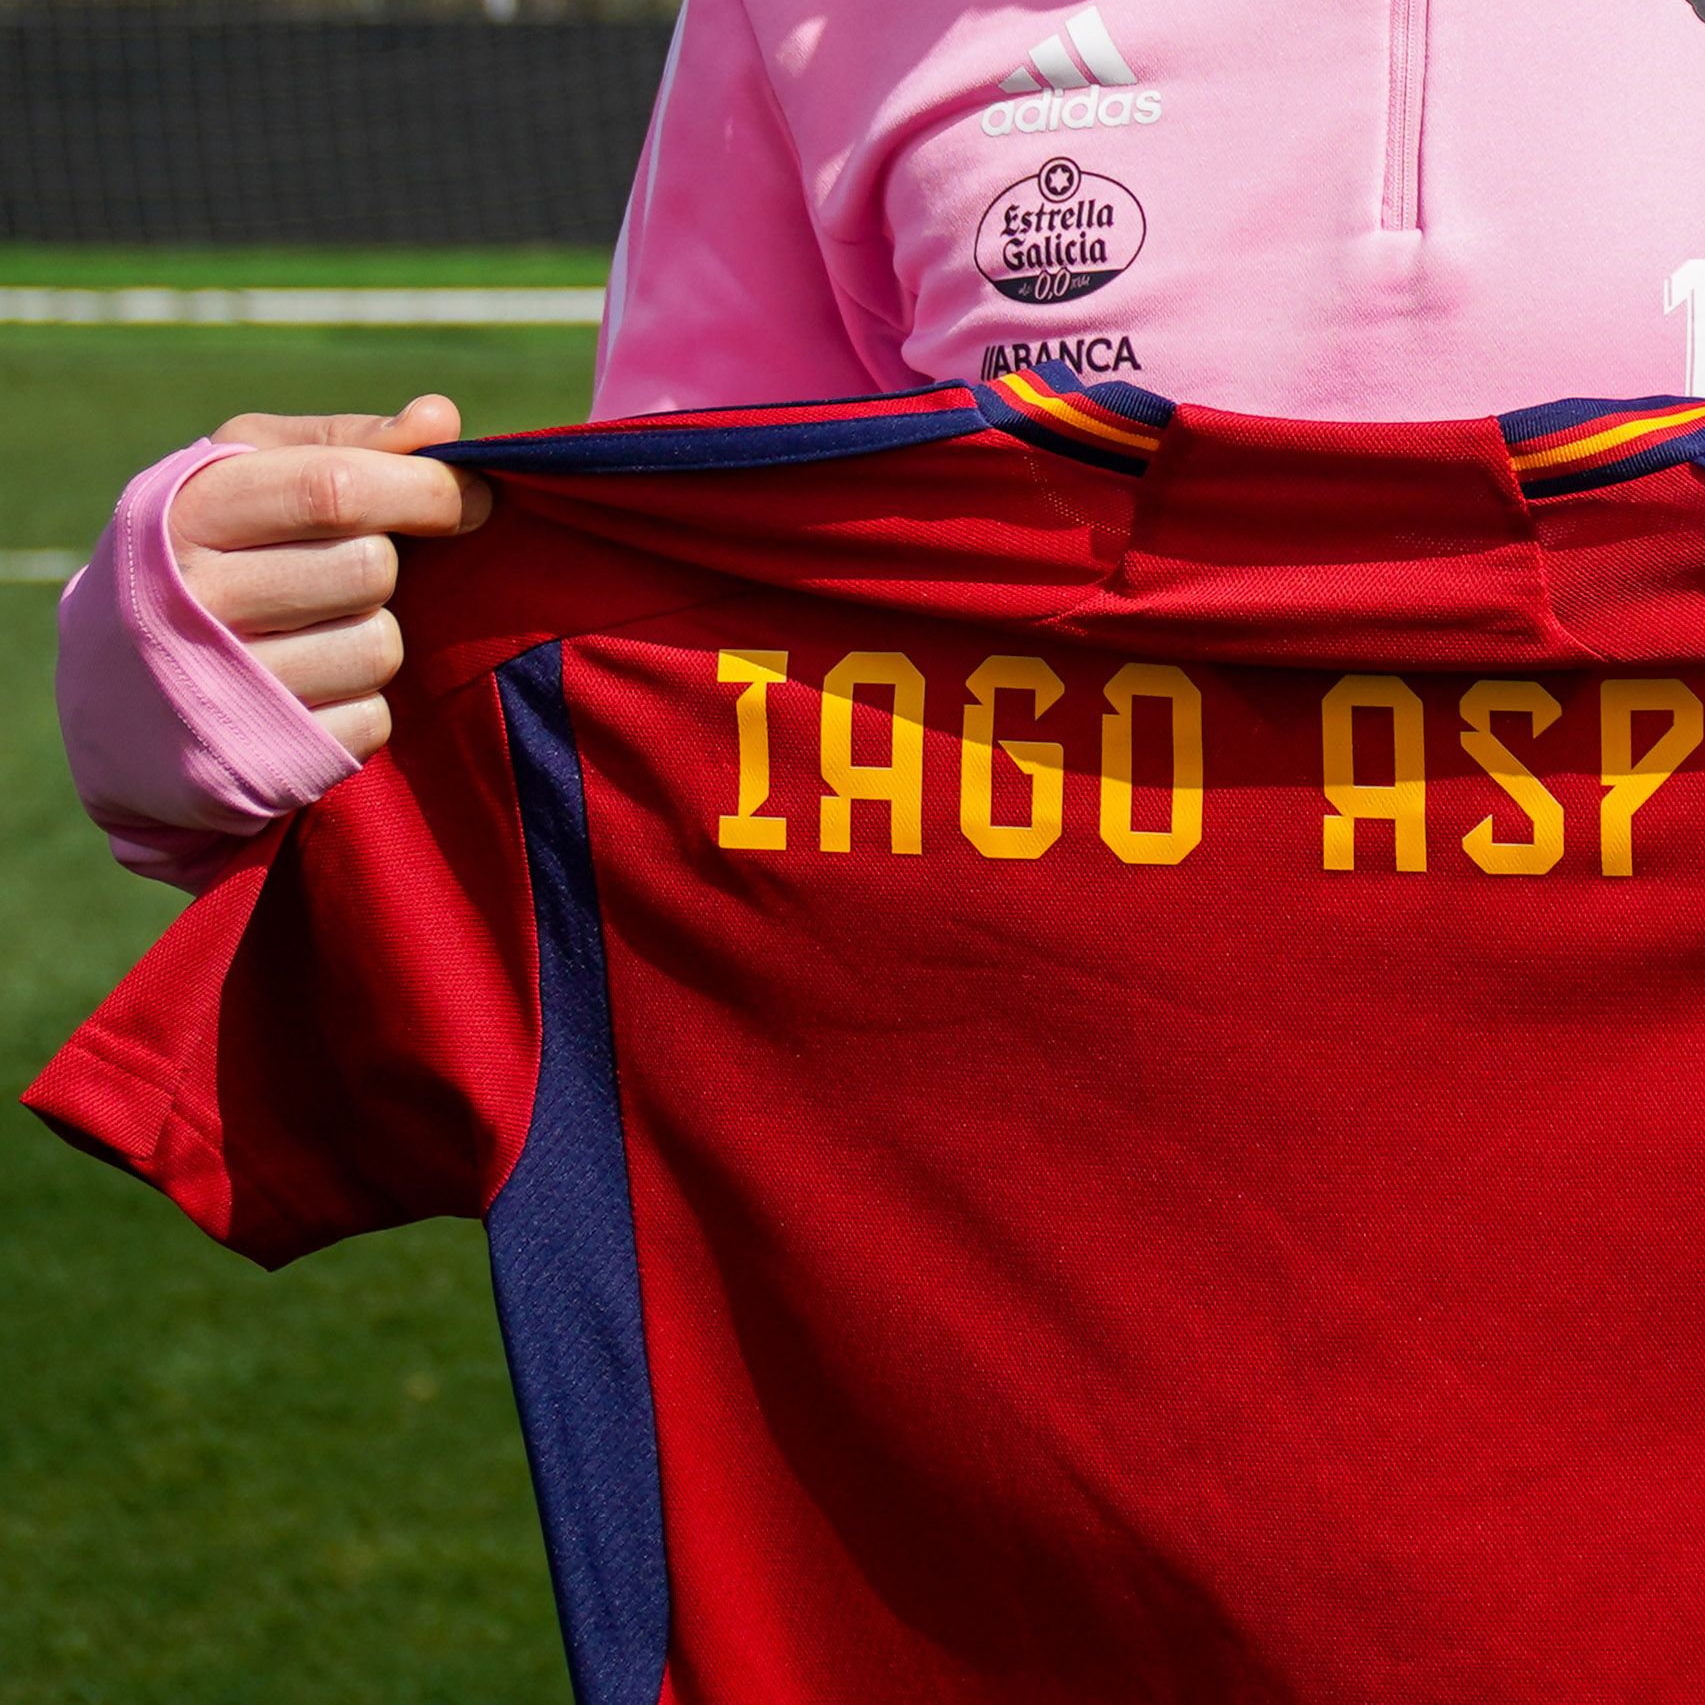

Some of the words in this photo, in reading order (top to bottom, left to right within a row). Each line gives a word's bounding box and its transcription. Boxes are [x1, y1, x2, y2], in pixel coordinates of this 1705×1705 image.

[981, 84, 1162, 137] adidas
[1001, 199, 1114, 237] Estrella
[1003, 232, 1107, 271] Galicia
[1034, 269, 1071, 300] 0,0
[718, 650, 1202, 866] IAGO
